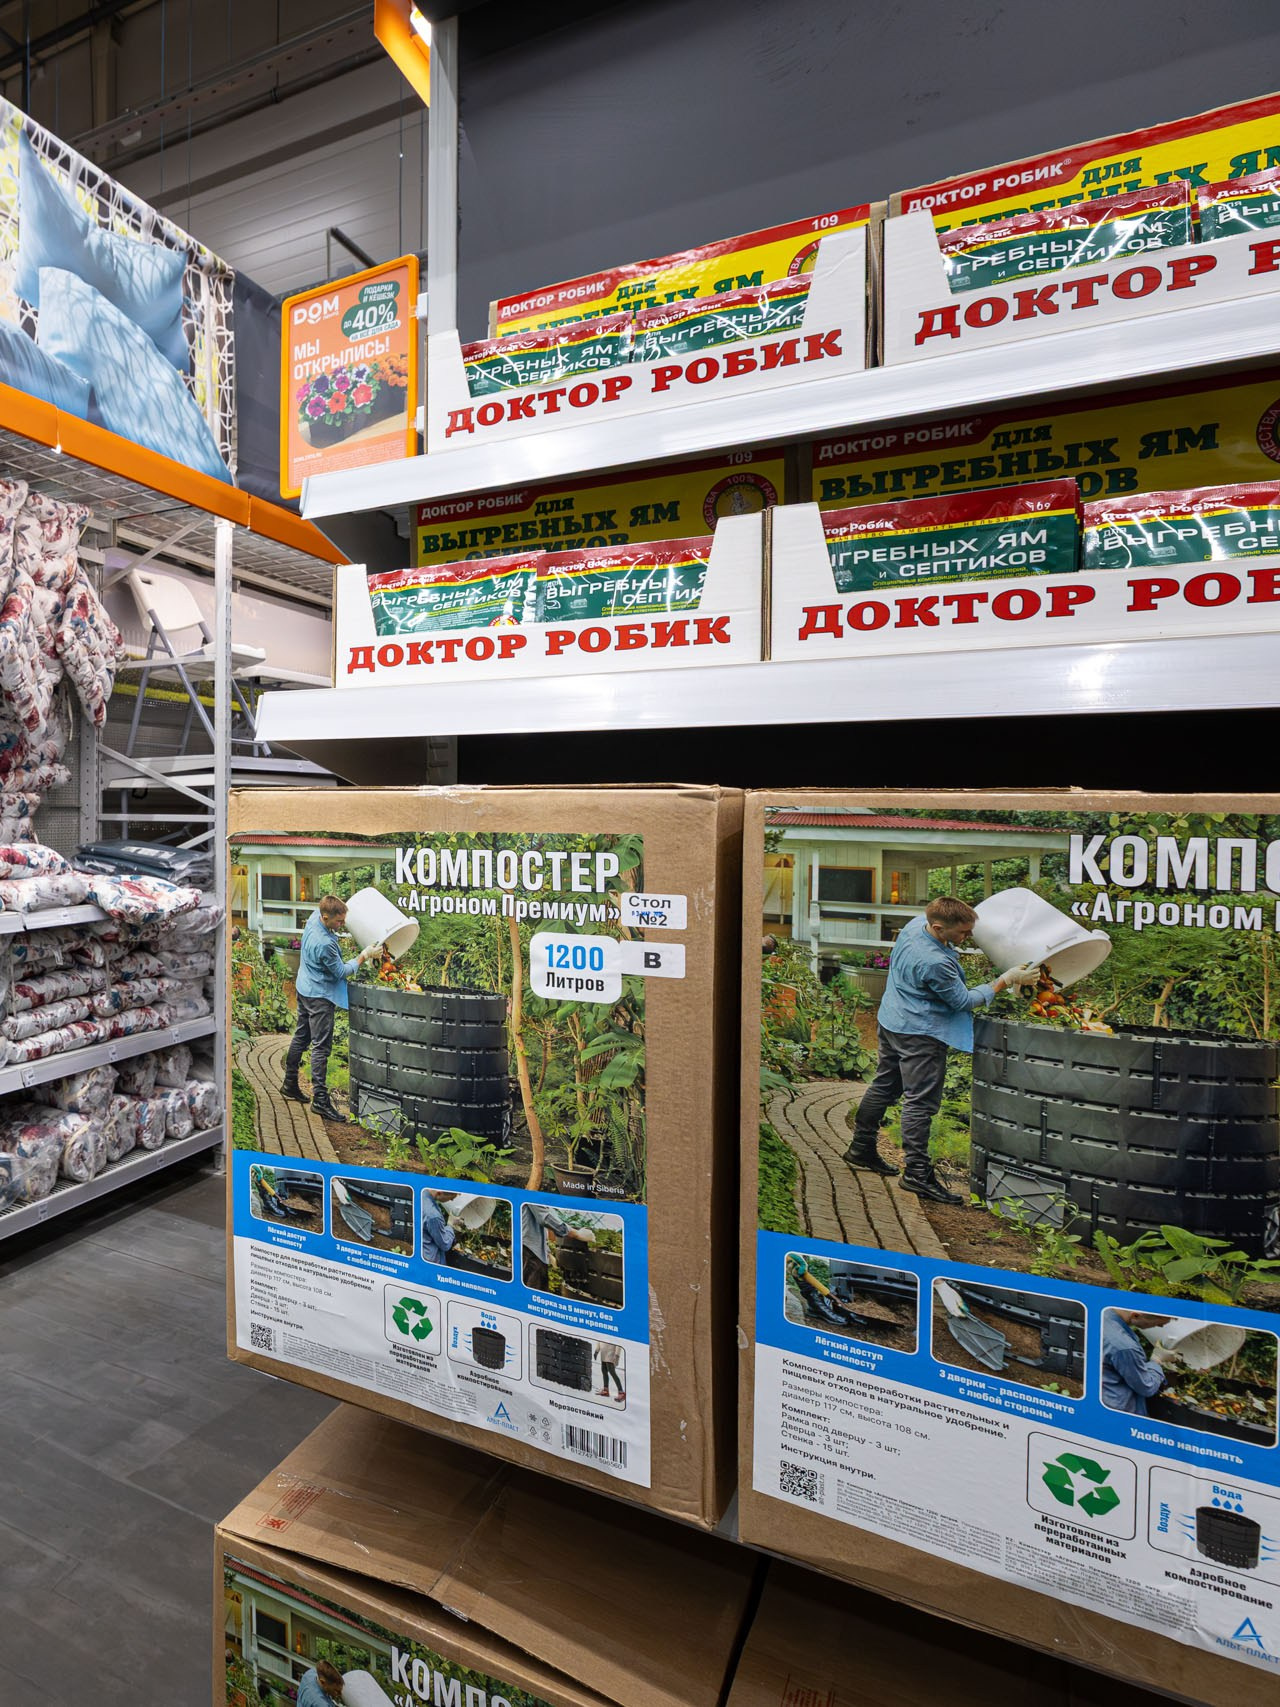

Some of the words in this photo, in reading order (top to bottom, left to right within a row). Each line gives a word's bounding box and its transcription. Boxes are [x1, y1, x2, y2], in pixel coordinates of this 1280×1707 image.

[1081, 157, 1142, 188] ДЛЯ
[907, 183, 986, 215] ДОКТОР
[993, 162, 1063, 189] РОБИК
[812, 215, 838, 230] 109
[364, 284, 393, 294] ПОДАРКИ
[501, 295, 554, 318] ДОКТОР
[558, 282, 605, 302] РОБИК
[617, 280, 657, 302] ДЛЯ
[915, 254, 1217, 346] ДОКТОР
[352, 302, 394, 330] 40%
[294, 339, 320, 361] МЫ
[294, 336, 390, 380] ОТКРЫЛИСЬ!
[466, 353, 570, 382] ЫГРЕБНЫХ
[445, 375, 632, 438] ДОКТОР
[651, 329, 842, 393] РОБИК
[820, 434, 897, 460] ДОКТОР
[904, 421, 974, 445] РОБИК
[991, 424, 1052, 451] ДЛЯ
[728, 451, 752, 465] 109
[820, 437, 1119, 501] ВЫГРЕБНЫХ
[1138, 423, 1219, 459] ЯМ
[422, 501, 473, 520] ДОКТОР
[478, 494, 523, 510] РОБИК
[534, 497, 574, 517] ДЛЯ
[423, 509, 617, 554] ВЫГРЕБНЫХ
[629, 500, 680, 526] ЯМ
[849, 521, 894, 533] Робик
[997, 530, 1047, 547] ЯМ
[548, 562, 586, 574] Доктор
[899, 550, 1046, 577] СЕПТИКОВ
[433, 590, 521, 611] СЕПТИКОВ
[546, 575, 684, 600] ВЫГРЕБНЫХ
[799, 584, 1096, 641] ДОКТОР
[347, 633, 527, 674] ДОКТОР
[545, 616, 731, 656] РОБИК
[395, 847, 621, 893] КОМПОСТЕР
[397, 890, 497, 917] «Агроном
[501, 894, 621, 926] Премиум»
[629, 895, 671, 909] Стол
[1070, 892, 1263, 931] «Агроном
[639, 914, 667, 926] №2
[545, 944, 603, 971] 1200
[546, 972, 605, 992] Литров
[563, 1181, 585, 1190] Made
[587, 1183, 594, 1191] in
[596, 1185, 624, 1195] Siberia
[437, 1274, 461, 1287] Удобно
[461, 1281, 496, 1295] наполнять
[481, 1312, 496, 1321] Вода
[527, 1303, 578, 1323] инструментов
[585, 1319, 619, 1332] крепежа
[532, 1294, 557, 1309] Сборка
[558, 1303, 567, 1311] за
[568, 1304, 573, 1312] 5
[573, 1307, 599, 1319] минут,
[599, 1312, 613, 1321] без
[389, 1350, 437, 1369] переработанных
[392, 1344, 425, 1359] Изготовлен
[815, 1335, 848, 1352] Лёгкий
[850, 1345, 883, 1361] доступ
[830, 1352, 876, 1371] компосту
[396, 1358, 430, 1373] материалов
[470, 1370, 499, 1385] Аэробное
[457, 1374, 513, 1396] компостирование
[782, 1358, 835, 1380] Компостер
[836, 1374, 854, 1385] для
[856, 1379, 921, 1404] переработки
[923, 1399, 1001, 1426] растительных
[939, 1369, 946, 1377] 3
[947, 1372, 986, 1389] дверки
[999, 1386, 1075, 1415] расположите
[549, 1399, 604, 1420] Морозостойкий
[782, 1381, 822, 1398] Размеры
[824, 1393, 883, 1417] компостера:
[782, 1368, 826, 1386] пищевых
[827, 1380, 867, 1398] отходов
[877, 1396, 943, 1420] натуральное
[945, 1415, 1007, 1440] удобрение.
[965, 1389, 1002, 1406] любой
[1004, 1400, 1053, 1420] стороны
[781, 1403, 831, 1424] Комплект:
[782, 1391, 821, 1409] диаметр
[823, 1401, 835, 1411] 117
[839, 1408, 855, 1418] см,
[857, 1413, 892, 1428] высота
[895, 1423, 911, 1433] 108
[914, 1430, 931, 1441] см.
[781, 1412, 811, 1428] Рамка
[812, 1423, 829, 1434] под
[831, 1427, 866, 1445] дверцу
[876, 1441, 882, 1449] 3
[884, 1446, 901, 1457] шт;
[781, 1421, 815, 1437] Дверца
[824, 1433, 831, 1441] 3
[833, 1438, 849, 1449] шт;
[781, 1430, 813, 1446] Стенка
[822, 1443, 832, 1451] 15
[835, 1447, 850, 1458] шт.
[1130, 1427, 1175, 1447] Удобно
[1177, 1441, 1244, 1464] наполнять
[781, 1443, 838, 1468] Инструкция
[840, 1463, 877, 1481] внутри.
[1212, 1485, 1242, 1501] Вода
[1041, 1515, 1104, 1544] Изготовлен
[1106, 1538, 1119, 1547] из
[1157, 1502, 1171, 1534] Воздух
[1034, 1523, 1127, 1559] переработанных
[1045, 1536, 1112, 1564] материалов
[1164, 1570, 1273, 1610] компостирование
[1190, 1567, 1247, 1591] Аэробное
